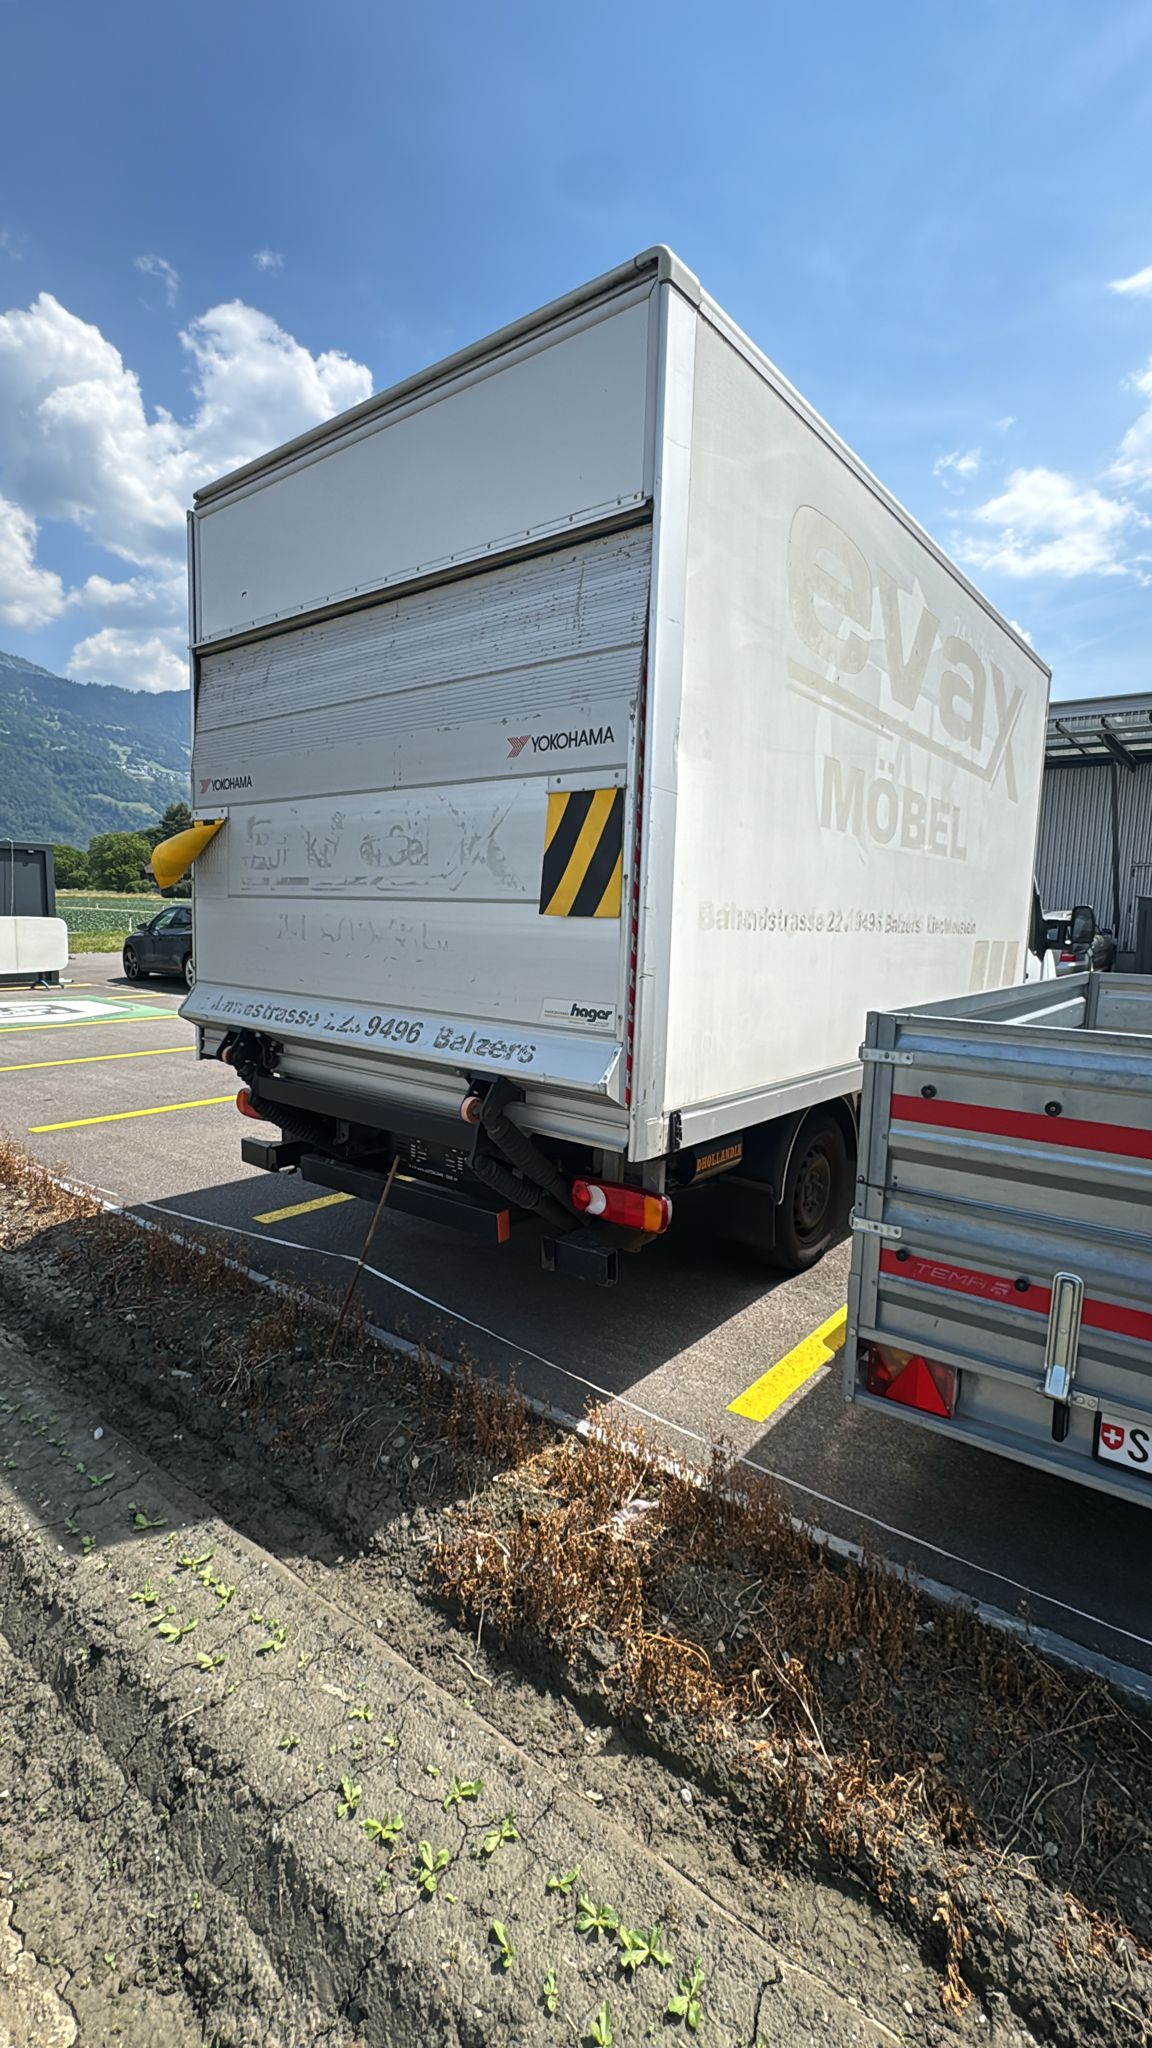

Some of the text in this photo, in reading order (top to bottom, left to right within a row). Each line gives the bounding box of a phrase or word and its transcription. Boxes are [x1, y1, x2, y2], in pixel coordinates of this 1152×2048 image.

[531, 726, 615, 752] YOKOHAMA
[211, 776, 252, 791] YOKOHAMA
[820, 755, 968, 861] MÖBEL
[570, 1003, 612, 1022] hager
[364, 1015, 424, 1044] 9496
[433, 1026, 537, 1063] Balzers
[1127, 1428, 1150, 1463] S
